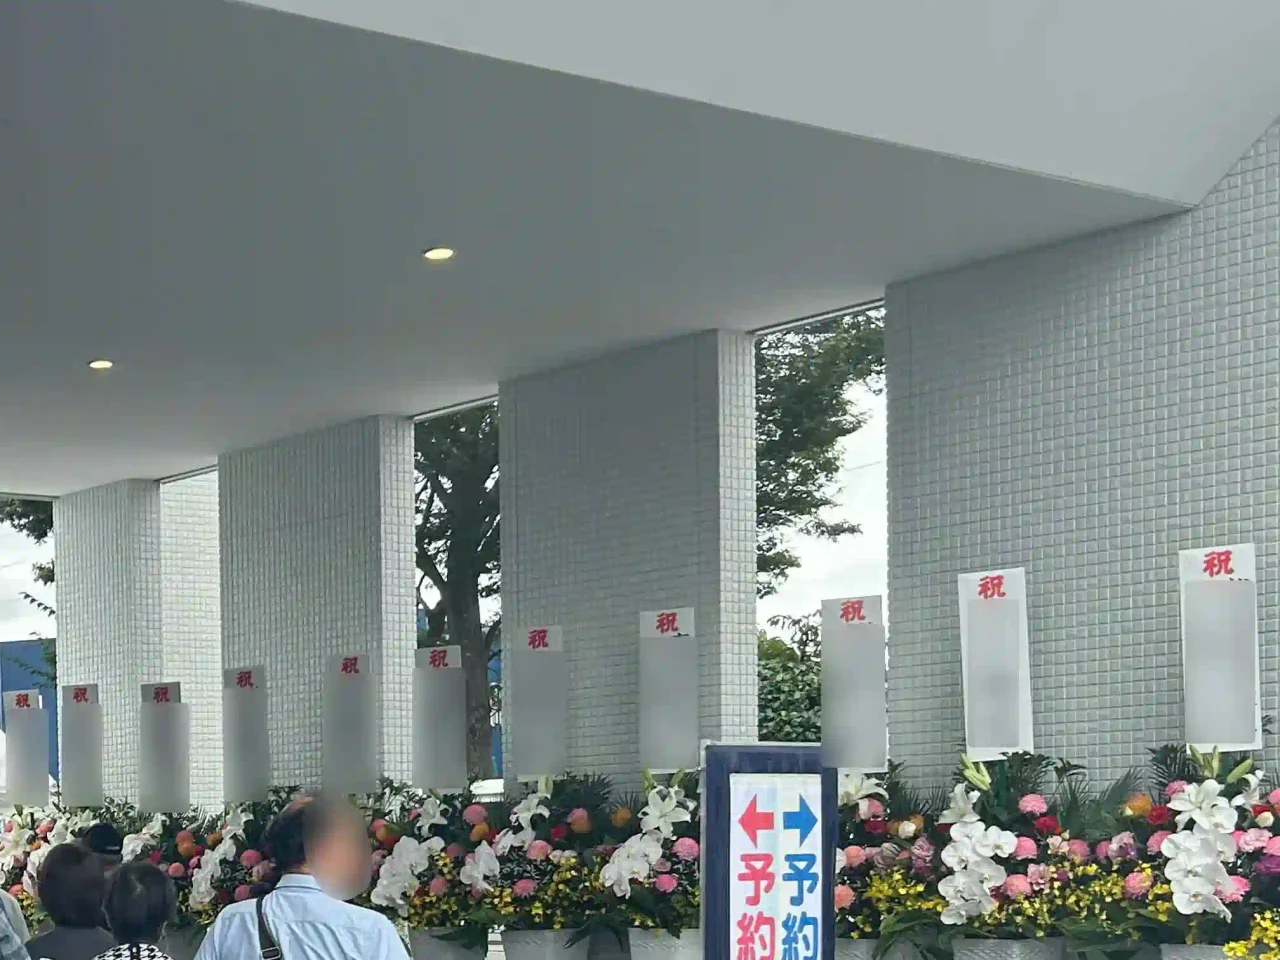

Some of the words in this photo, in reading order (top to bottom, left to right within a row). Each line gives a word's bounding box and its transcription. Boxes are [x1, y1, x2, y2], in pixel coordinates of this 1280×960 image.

[1204, 550, 1234, 577] 祝
[978, 574, 1007, 600] 祝
[841, 600, 864, 622] 祝
[657, 612, 679, 633] 祝
[528, 629, 548, 649] 祝
[341, 657, 359, 674] 祝
[430, 649, 448, 667] 祝
[236, 671, 254, 688] 祝
[15, 694, 30, 707] 祝
[73, 688, 89, 702] 祝
[153, 687, 170, 702] 祝
